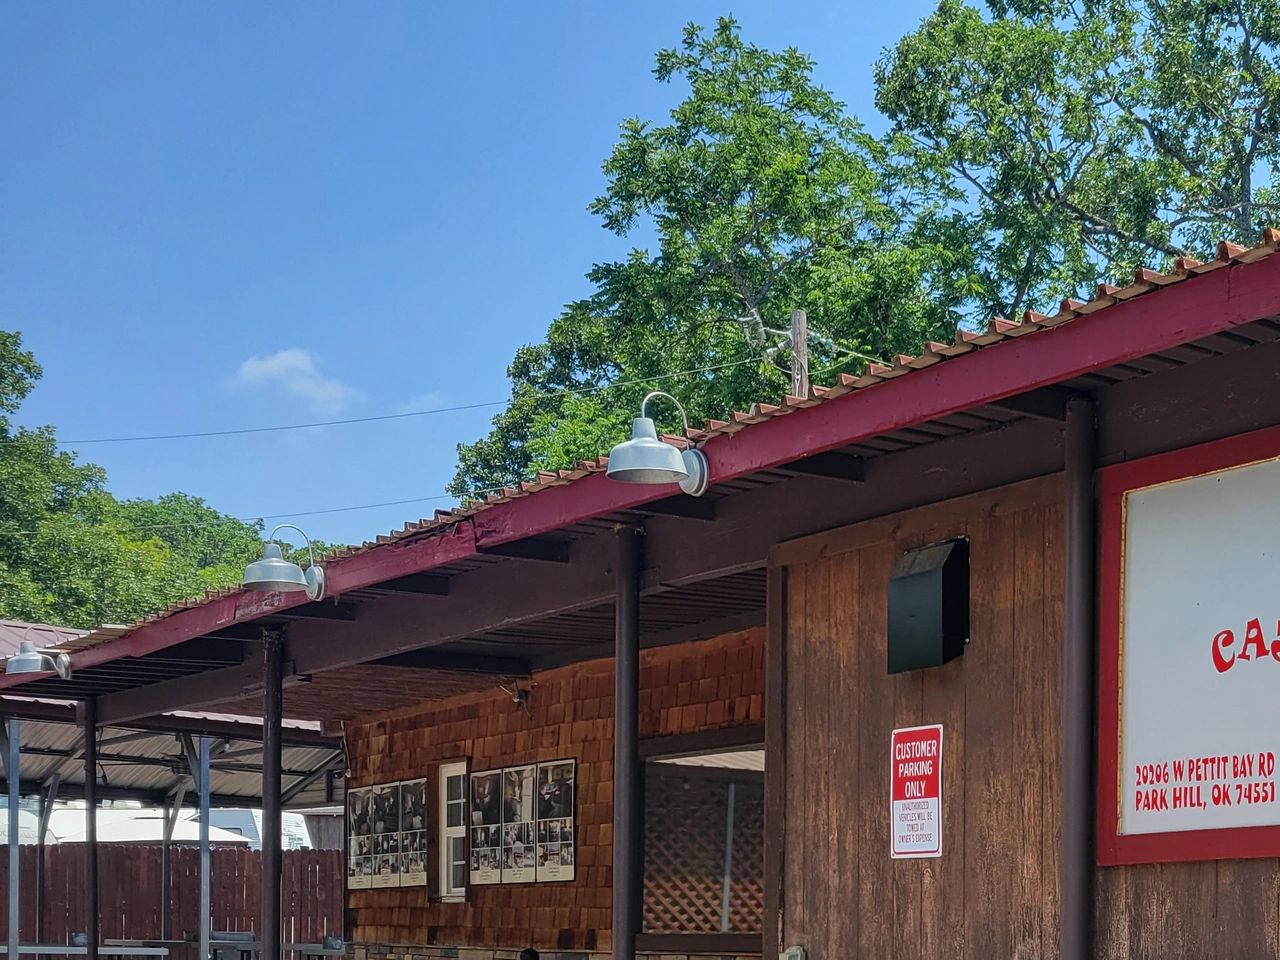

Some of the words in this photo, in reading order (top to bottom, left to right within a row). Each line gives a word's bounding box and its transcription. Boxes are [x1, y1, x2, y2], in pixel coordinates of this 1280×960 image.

[895, 740, 937, 760] CUSTOMER
[898, 760, 933, 778] PARKING
[1135, 762, 1169, 786] 20206
[1173, 759, 1184, 782] W
[1188, 755, 1229, 782] PETTIT
[1232, 753, 1254, 779] BAY
[1258, 751, 1275, 778] RD
[905, 780, 926, 798] ONLY
[1135, 787, 1169, 812] PARK
[1172, 785, 1206, 811] HILL,
[1211, 783, 1232, 806] OK
[1235, 780, 1276, 805] 74551
